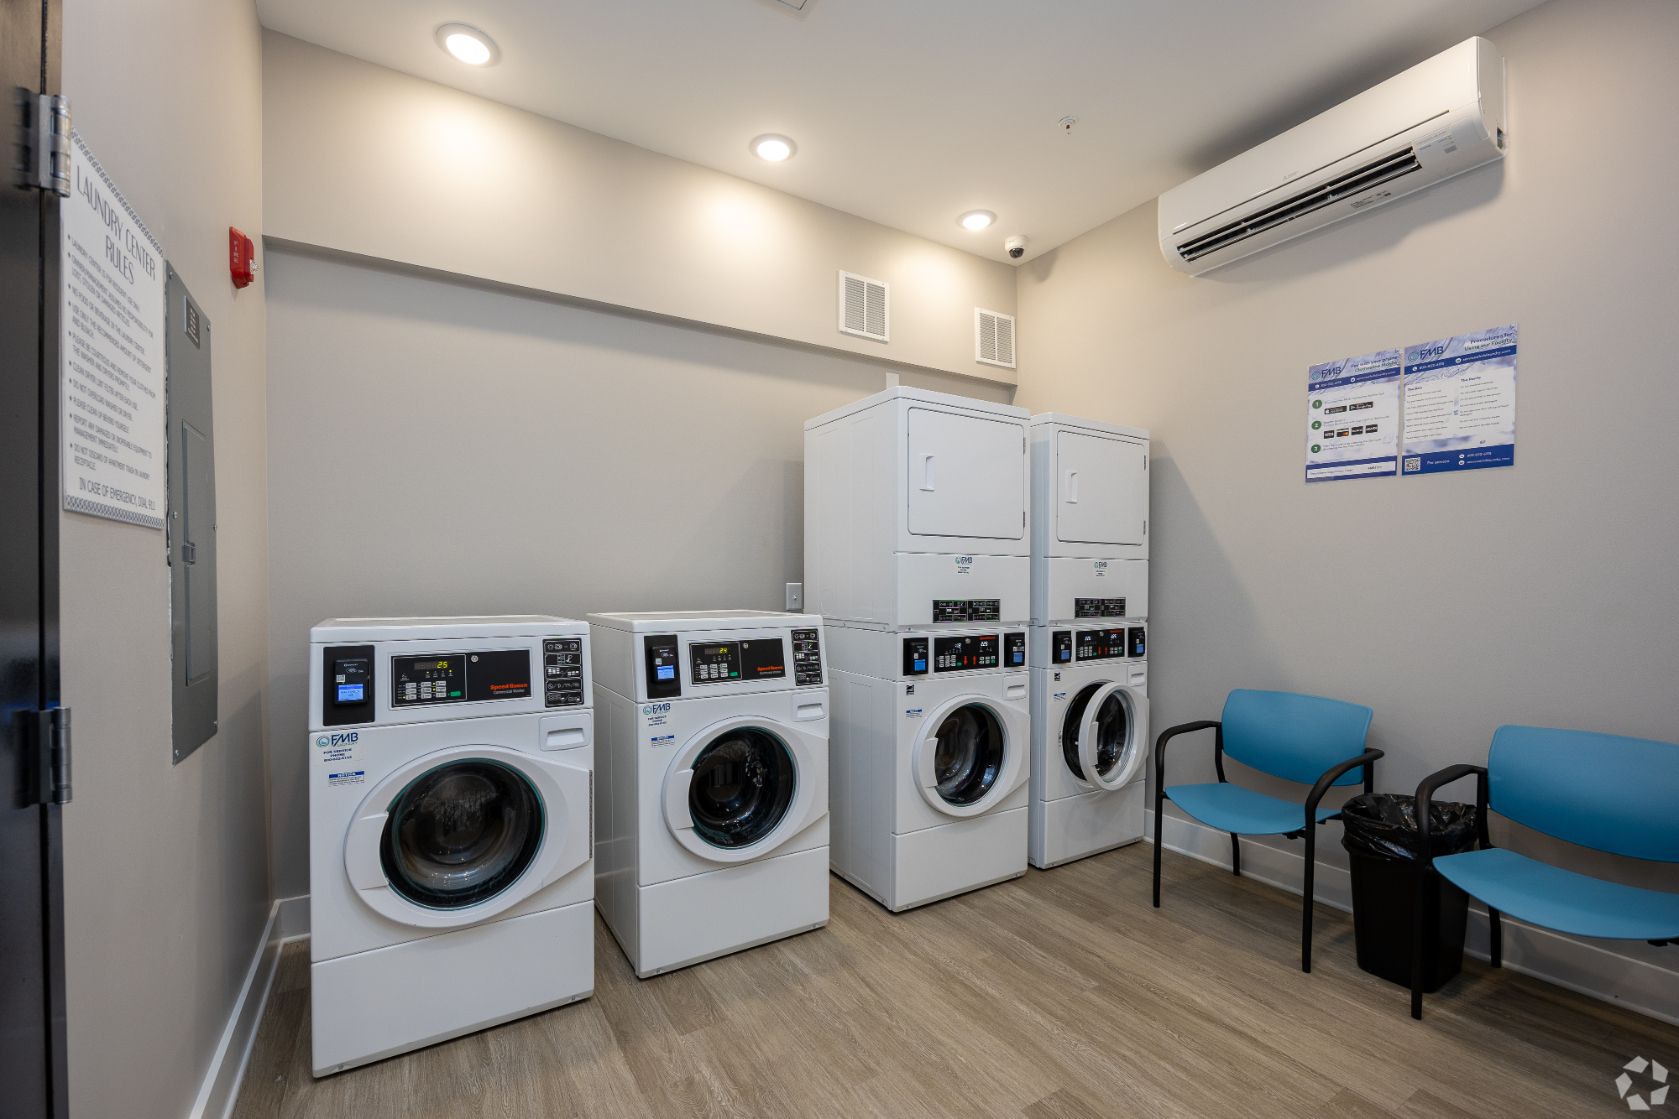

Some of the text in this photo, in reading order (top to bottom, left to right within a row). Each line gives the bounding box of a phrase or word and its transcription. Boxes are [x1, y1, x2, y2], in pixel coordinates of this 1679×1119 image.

[76, 164, 155, 282] LAUNDRY CENTER
[105, 233, 134, 287] RULES
[1420, 346, 1443, 360] FMB
[1321, 367, 1341, 378] FMB
[79, 477, 85, 491] IN
[87, 479, 100, 495] CASE
[102, 484, 108, 497] OF
[138, 495, 147, 508] DIAL
[437, 661, 448, 669] 25
[653, 703, 671, 714] FMB
[331, 733, 359, 747] FMB
